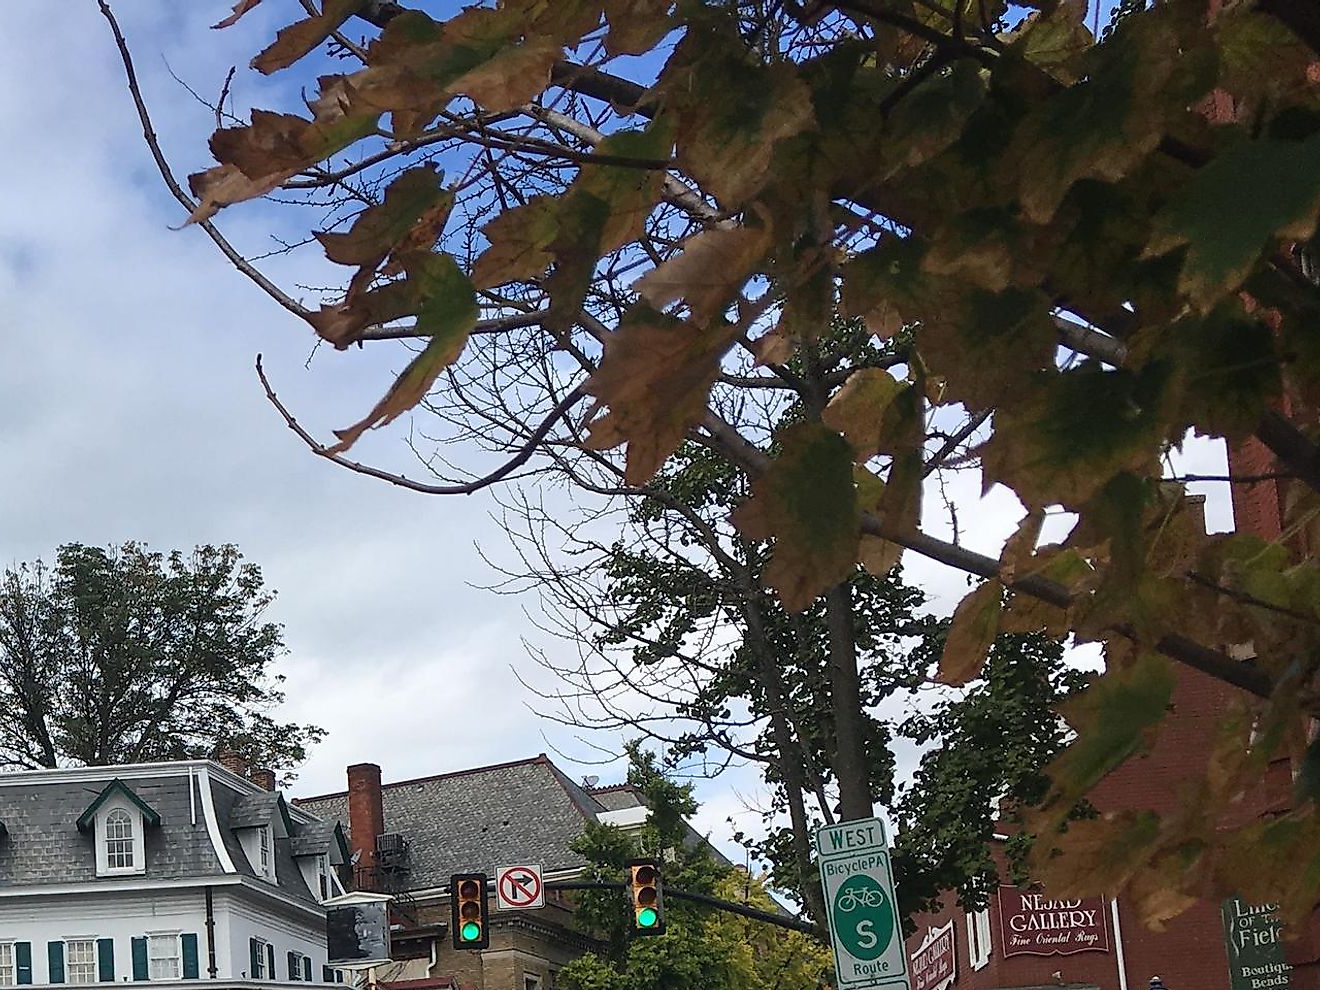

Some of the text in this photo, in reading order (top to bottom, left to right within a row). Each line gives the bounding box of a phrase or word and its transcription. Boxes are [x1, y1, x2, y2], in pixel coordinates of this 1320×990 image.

[829, 827, 875, 850] WEST
[826, 856, 885, 876] BicyclePA
[1009, 910, 1096, 932] GALLERY
[855, 919, 878, 949] S
[1009, 930, 1099, 946] Fine Oriental Rugs
[853, 961, 889, 976] Route
[1251, 975, 1289, 989] Beads
